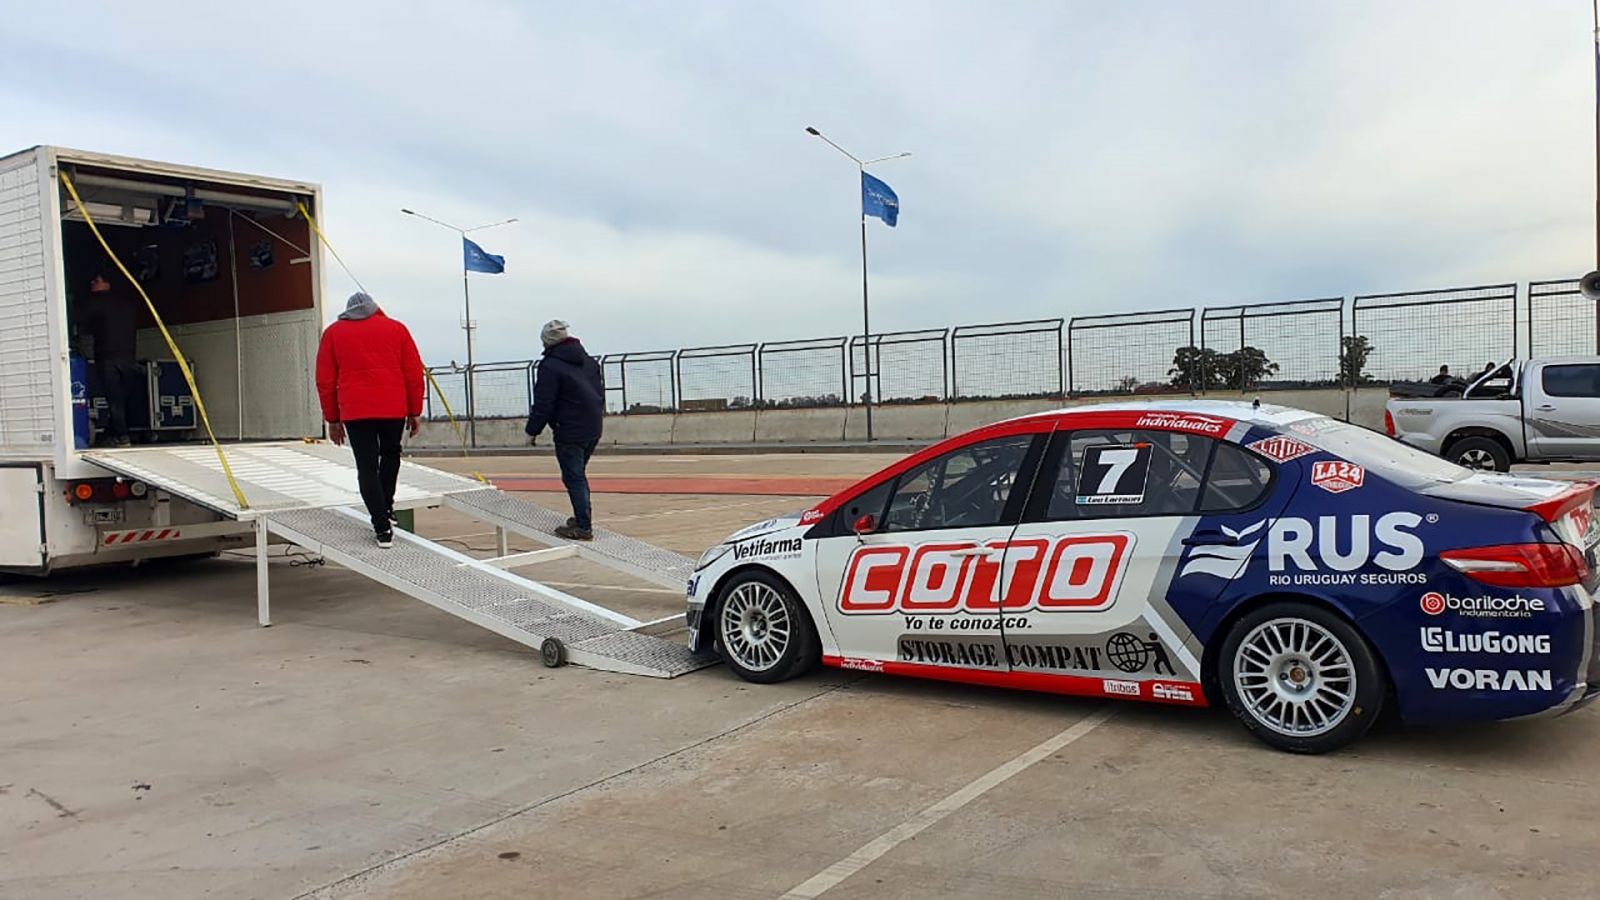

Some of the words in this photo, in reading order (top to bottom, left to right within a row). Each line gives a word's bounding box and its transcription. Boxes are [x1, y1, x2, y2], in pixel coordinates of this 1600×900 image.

[1136, 415, 1222, 433] individuales
[1260, 438, 1304, 458] LOTUS
[1097, 449, 1139, 494] 7
[1315, 461, 1361, 482] LA24
[733, 537, 803, 560] Vetifarma
[1267, 511, 1425, 572] RUS
[842, 537, 1124, 609] COTO
[1269, 574, 1291, 586] RIO
[1294, 573, 1357, 585] URUGUAY
[1360, 573, 1428, 584] SEGUROS
[1446, 593, 1545, 611] bariloche
[904, 615, 922, 630] Yo
[928, 616, 945, 630] te
[950, 617, 1033, 630] conozco.
[900, 639, 999, 668] STORAGE
[1004, 644, 1103, 671] COMPAT
[1424, 667, 1553, 691] VORAN
